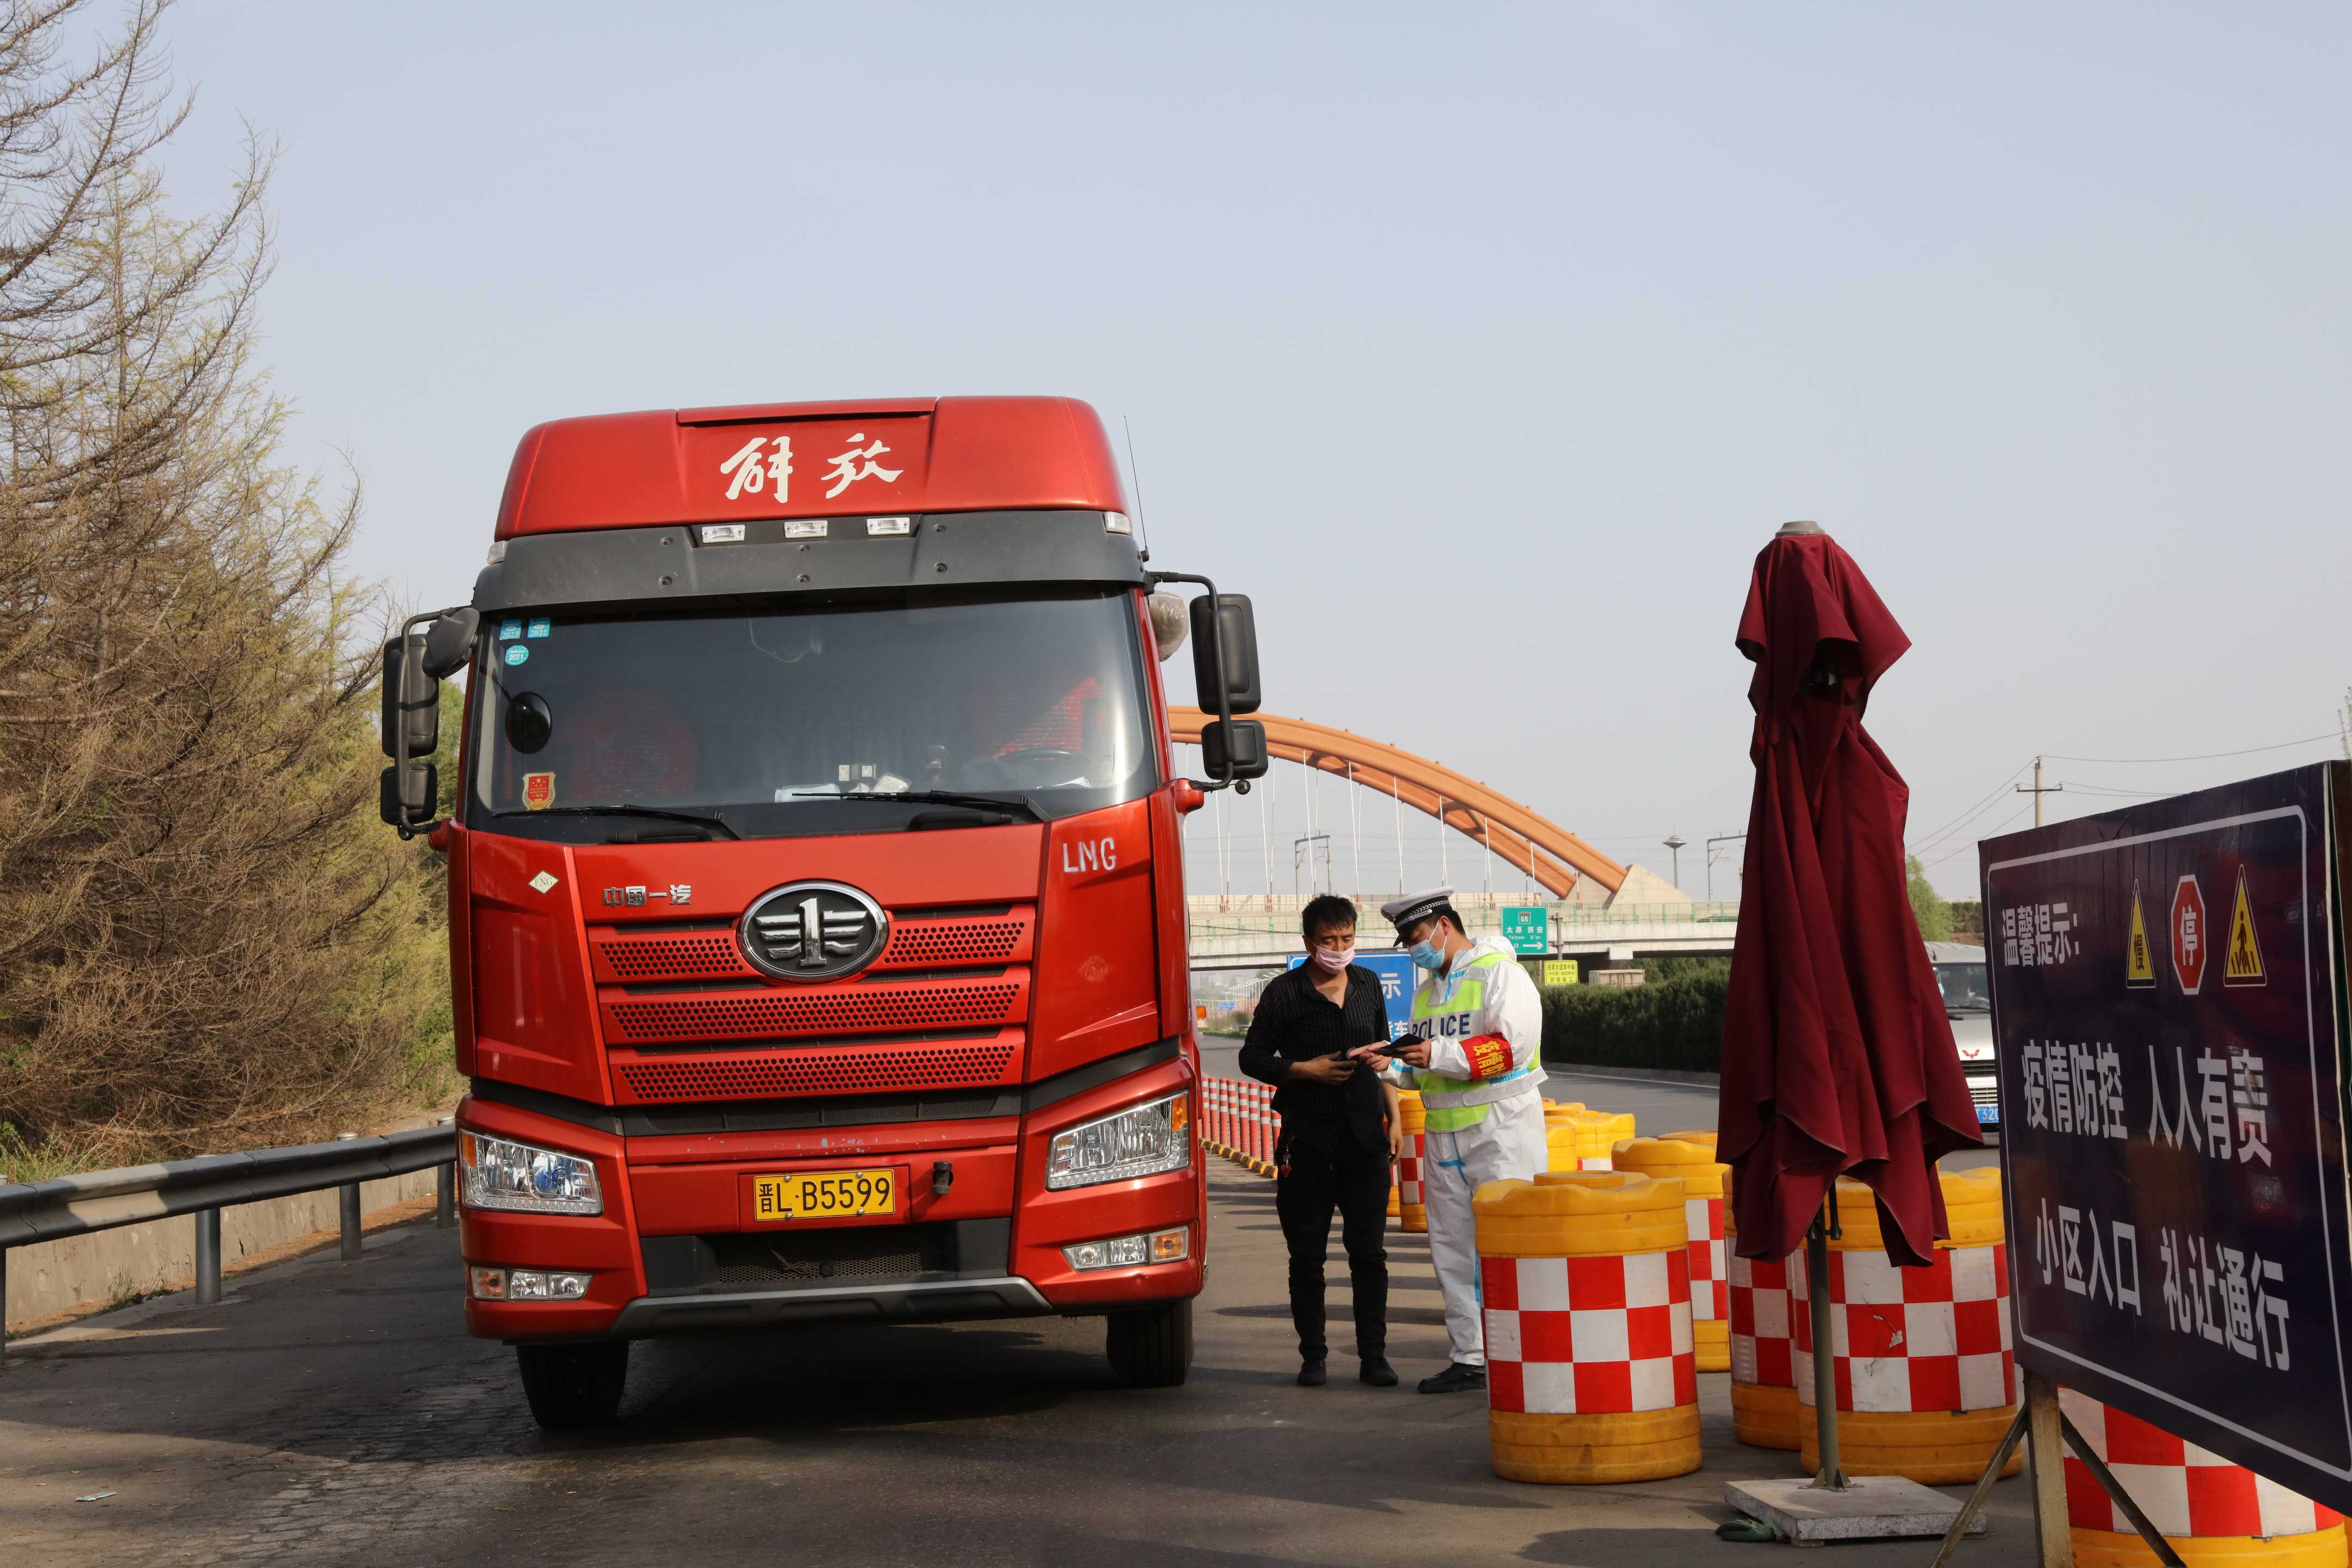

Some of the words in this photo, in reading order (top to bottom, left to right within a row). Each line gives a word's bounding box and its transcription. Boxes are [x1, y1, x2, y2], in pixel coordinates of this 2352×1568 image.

[720, 433, 904, 504] 解放
[1063, 837, 1116, 872] LNG
[534, 877, 553, 887] LNG
[603, 884, 691, 907] 中国一汽
[2179, 904, 2198, 966] 停
[1412, 1013, 1471, 1039] POLICE
[2021, 1039, 2128, 1140] 疫情防控
[2148, 1045, 2272, 1168] 人人有责
[2036, 1197, 2142, 1316] 小区入口
[2160, 1226, 2290, 1371] 礼让通行
